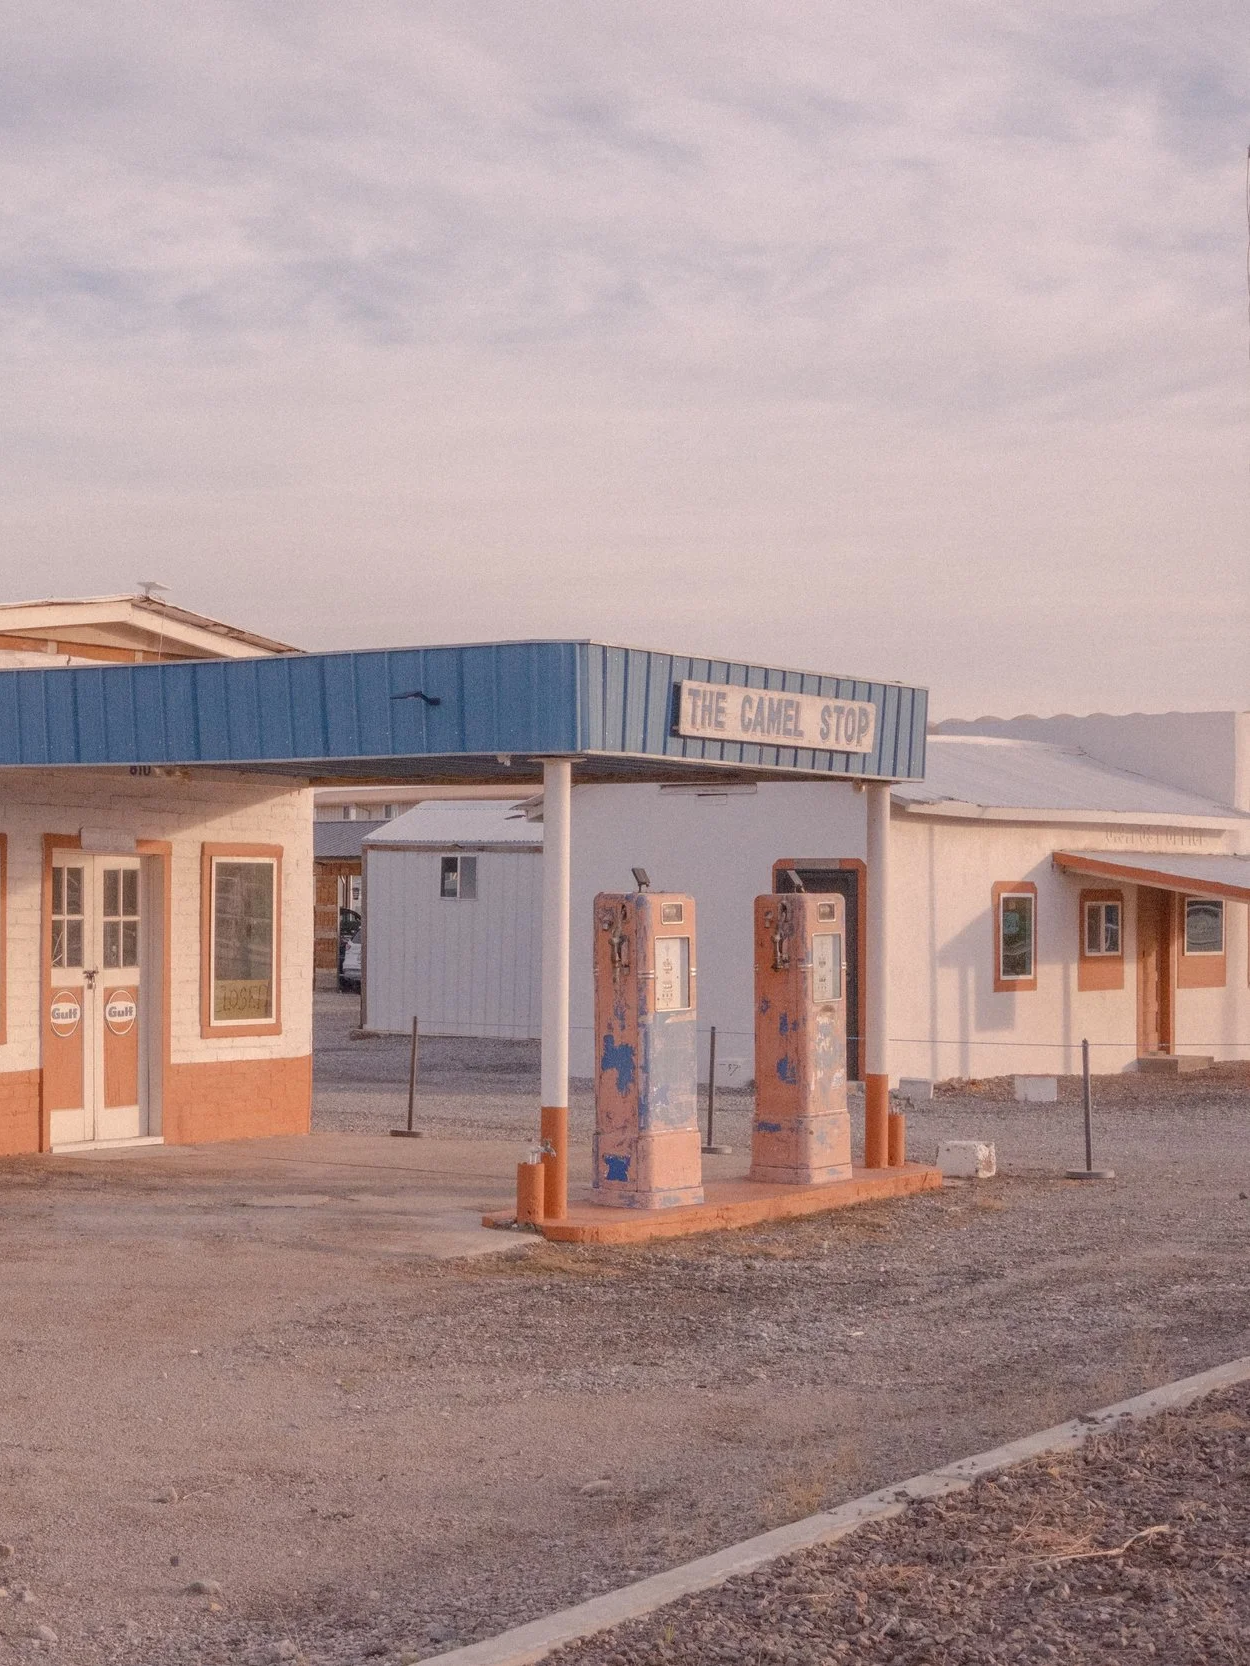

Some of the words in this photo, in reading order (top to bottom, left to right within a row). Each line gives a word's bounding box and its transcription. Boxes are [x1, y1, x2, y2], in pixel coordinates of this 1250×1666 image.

[687, 688, 727, 730] THE
[739, 693, 804, 739] CAMEL
[819, 703, 870, 748] STOP
[51, 1007, 78, 1020] Gulf
[107, 1006, 134, 1018] Gulf
